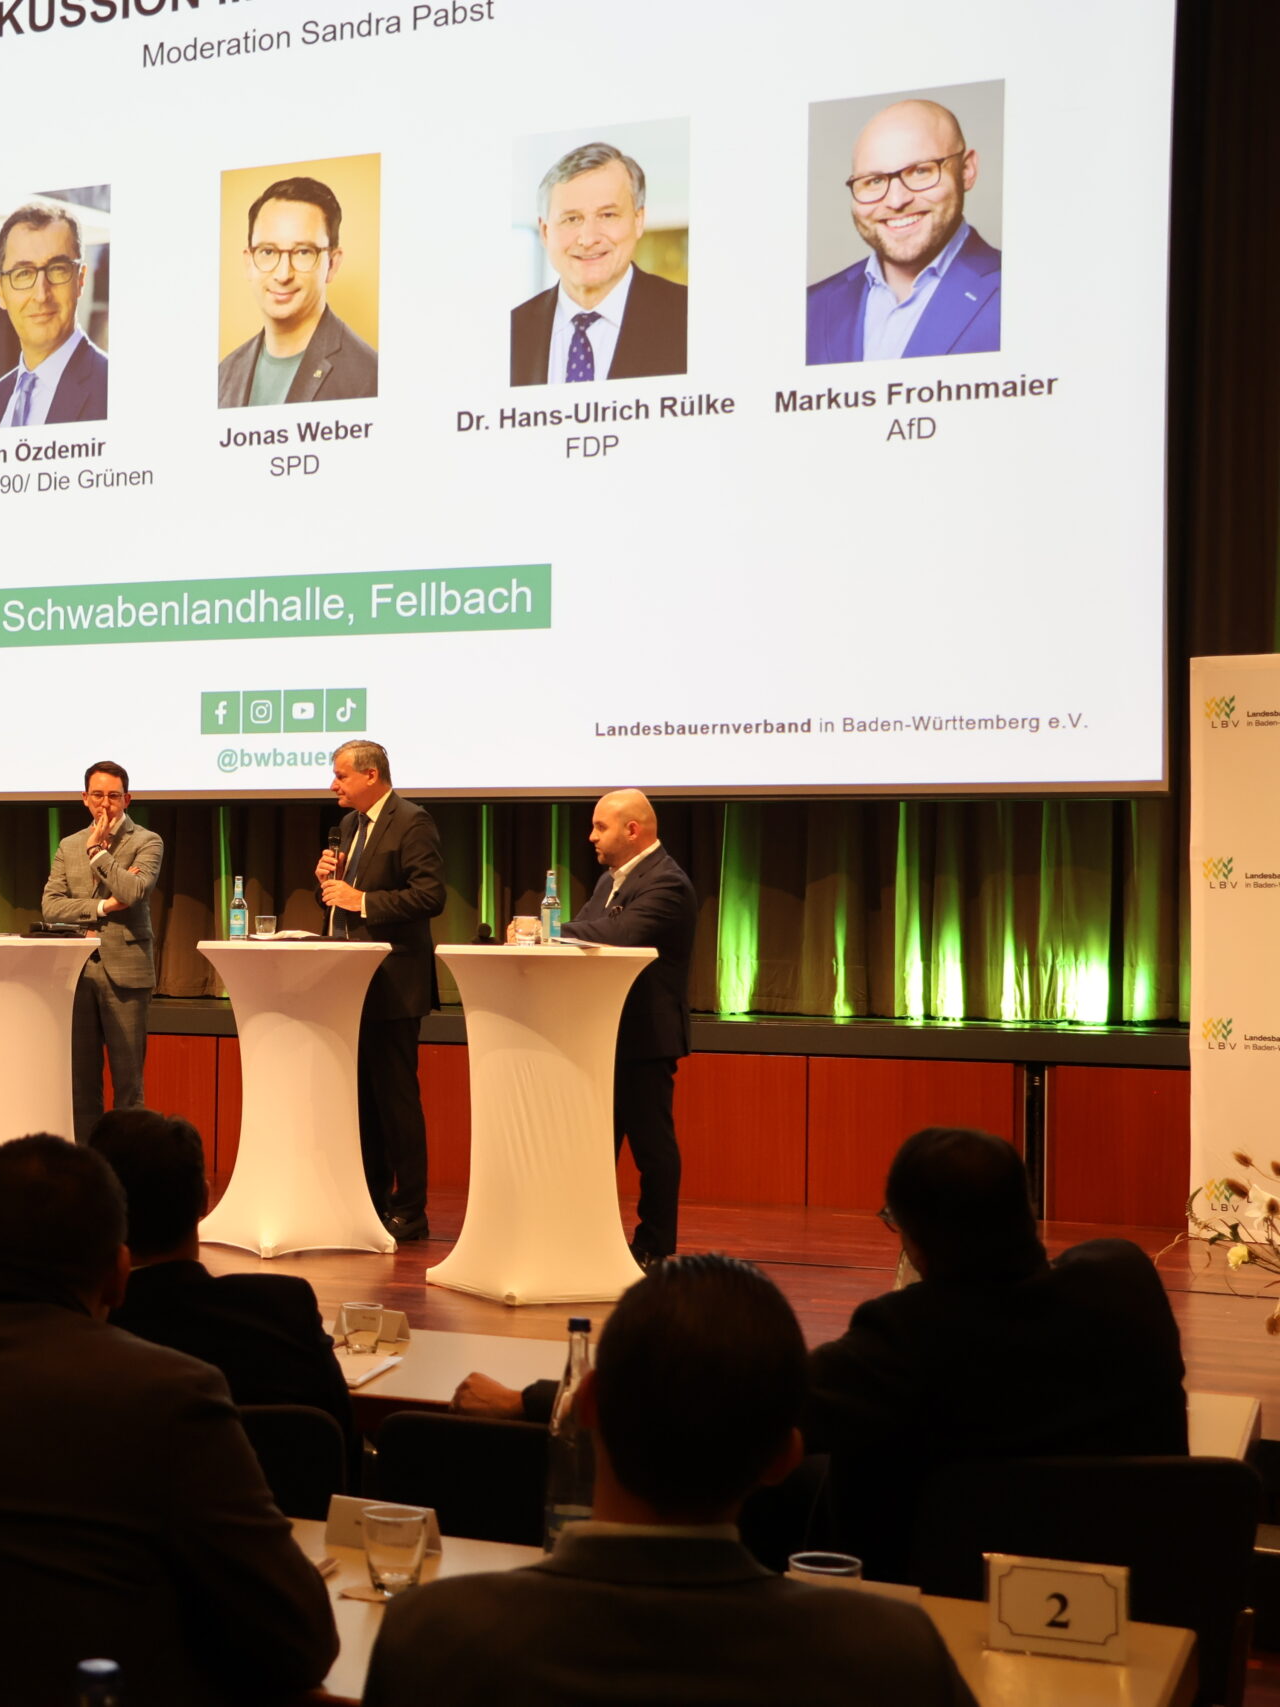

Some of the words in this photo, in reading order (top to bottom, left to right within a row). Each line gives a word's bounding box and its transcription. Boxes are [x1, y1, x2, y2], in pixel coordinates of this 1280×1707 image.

[142, 28, 291, 68] Moderation
[301, 12, 401, 45] Sandra
[412, 0, 495, 31] Pabst
[775, 387, 877, 413] Markus
[887, 373, 1059, 406] Frohnmaier
[456, 410, 490, 432] Dr.
[499, 398, 650, 429] Hans-Ulrich
[660, 393, 735, 419] Rülke
[219, 426, 289, 448] Jonas
[296, 419, 374, 443] Weber
[886, 416, 937, 442] AfD
[15, 437, 106, 463] Özdemir
[566, 434, 620, 459] FDP
[269, 455, 320, 477] SPD
[36, 472, 71, 492] Die
[77, 468, 154, 489] Grünen
[1, 586, 355, 633] Schwabenlandhalle,
[371, 577, 532, 619] Fellbach
[595, 717, 812, 737] Landesbauernverband
[819, 717, 835, 733] in
[842, 713, 1041, 734] Baden-Württemberg
[1047, 713, 1088, 729] e.V.
[1211, 720, 1240, 728] LBV
[1209, 881, 1238, 889] LBV
[1253, 881, 1280, 889] Baden-
[1208, 1042, 1237, 1050] LBV
[1211, 1203, 1240, 1213] LBV
[1045, 1592, 1070, 1630] 2
